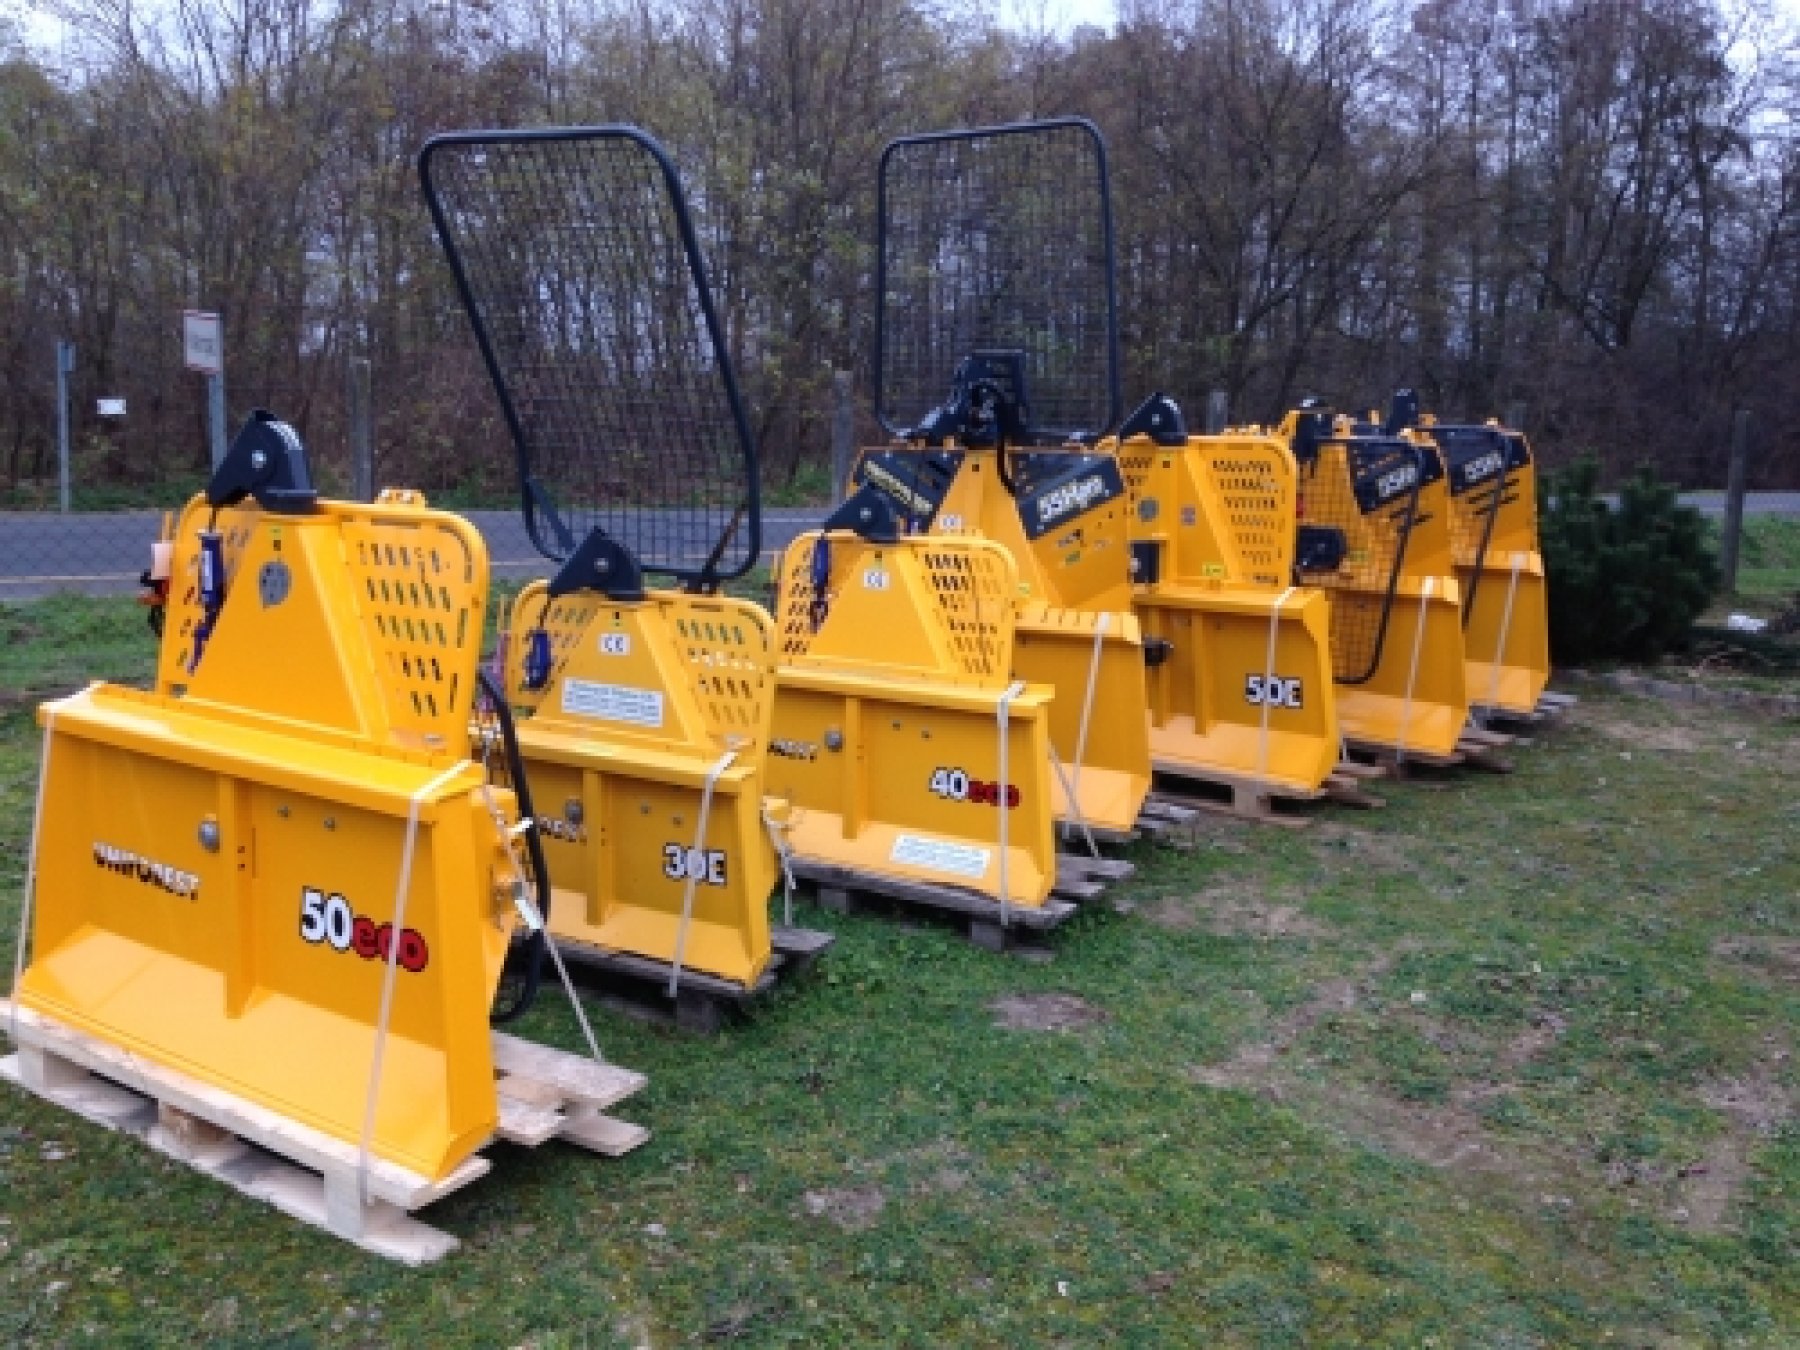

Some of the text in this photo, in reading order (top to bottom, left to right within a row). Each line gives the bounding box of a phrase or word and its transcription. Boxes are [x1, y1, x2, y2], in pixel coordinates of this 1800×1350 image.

[1245, 673, 1304, 710] 50E
[662, 841, 728, 889] 30E
[299, 885, 429, 973] 50eco
